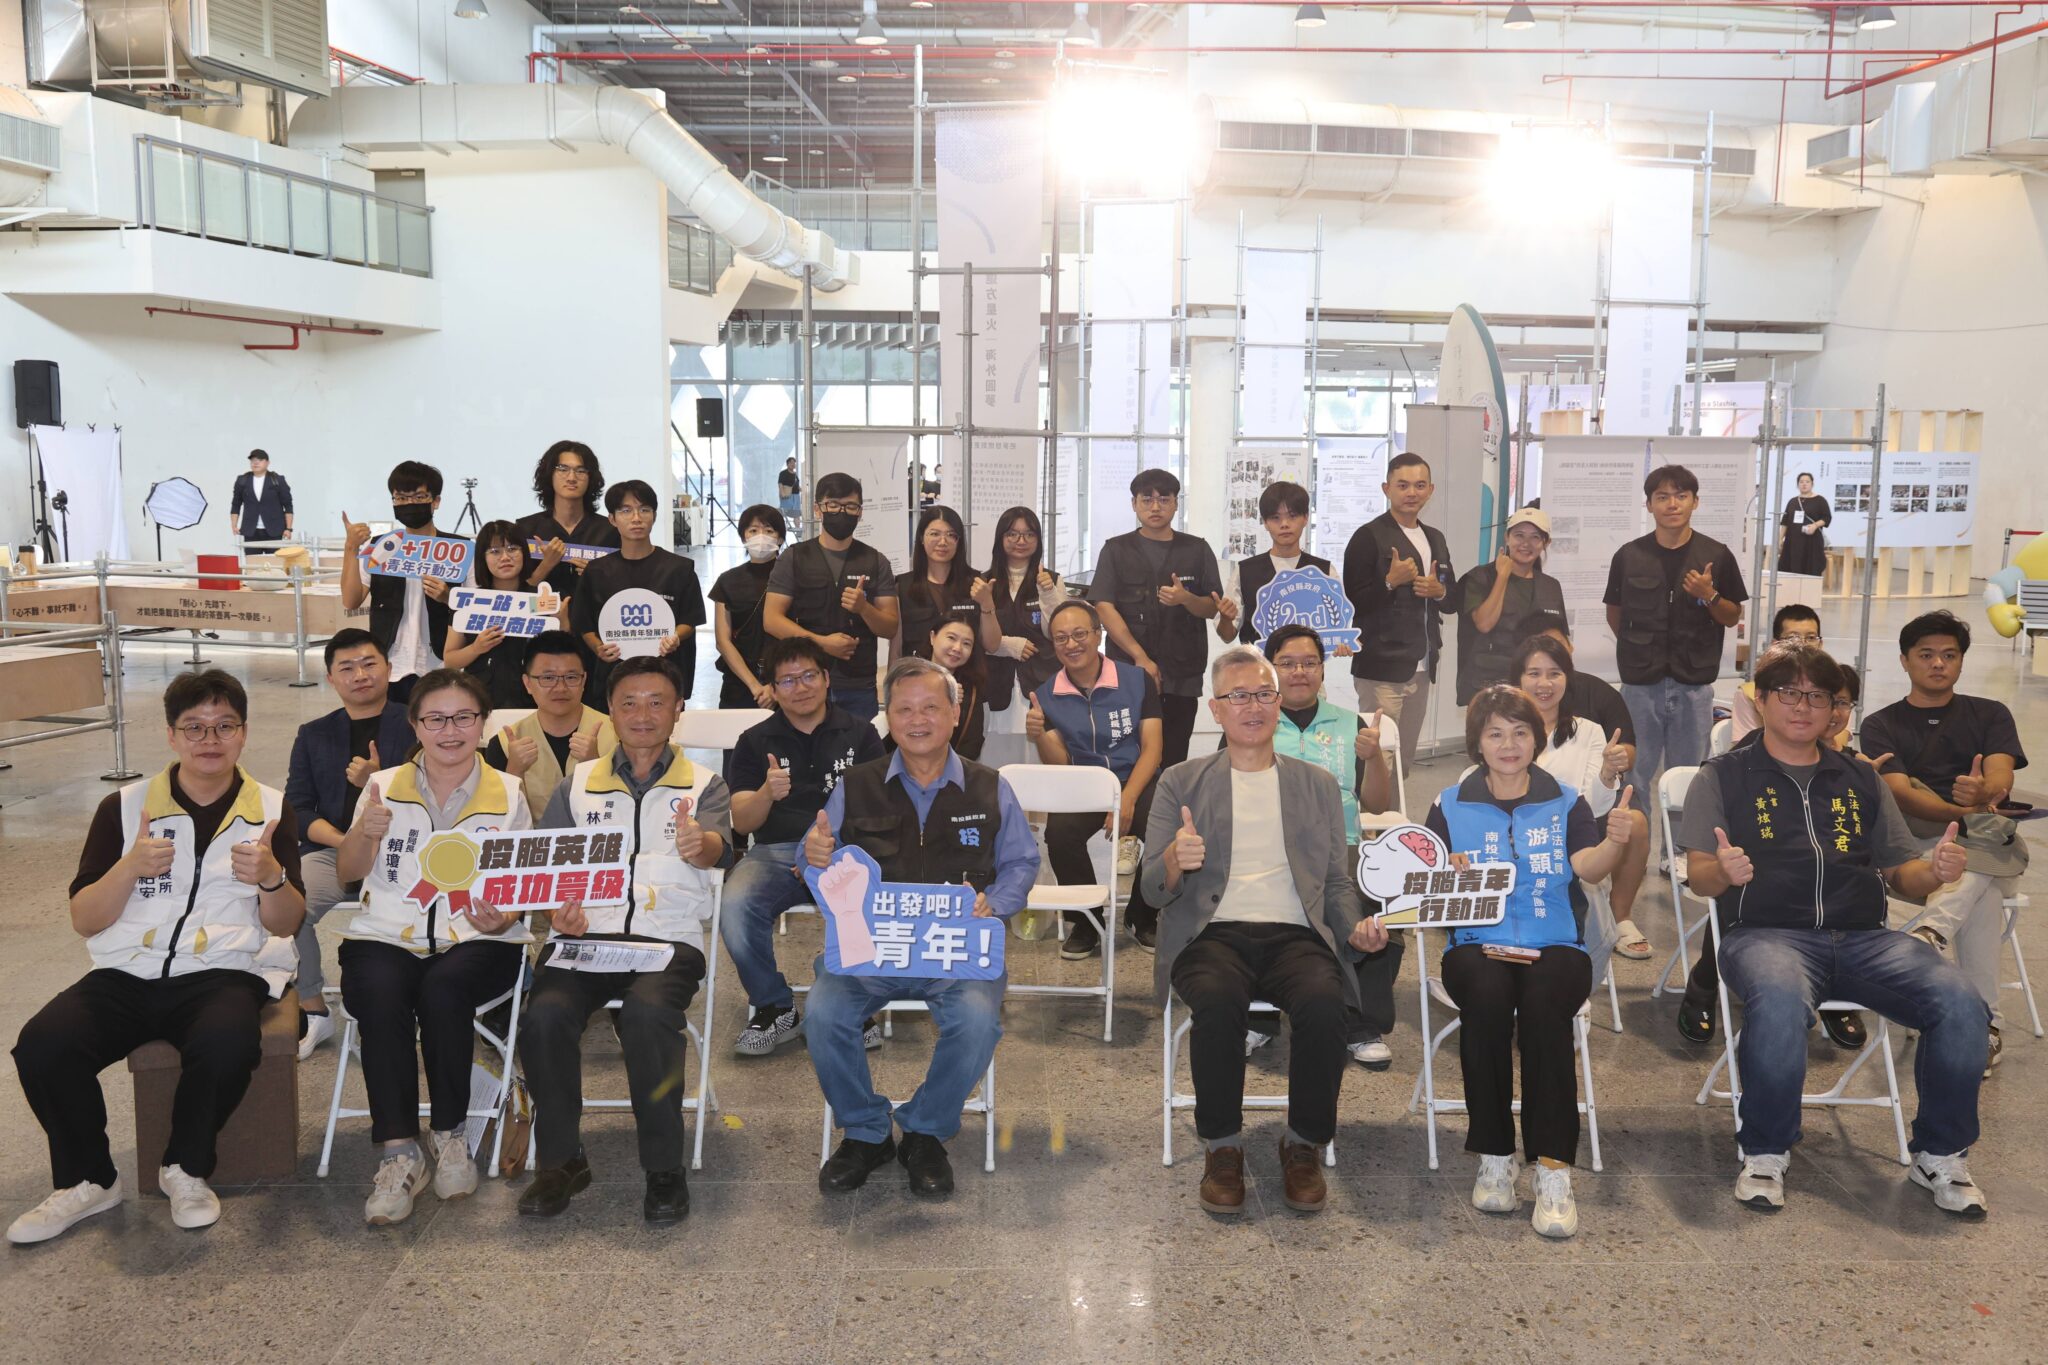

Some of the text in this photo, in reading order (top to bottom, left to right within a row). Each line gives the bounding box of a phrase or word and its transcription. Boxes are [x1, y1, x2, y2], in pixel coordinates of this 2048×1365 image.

[402, 540, 467, 563] +100
[386, 558, 462, 579] 青年行動力
[1280, 602, 1327, 628] 2nd
[605, 629, 669, 637] 南投縣青年發展所
[603, 801, 614, 820] 局長
[1848, 787, 1862, 836] 立法委員
[1831, 797, 1851, 853] 馬文君
[479, 832, 623, 870] 投腦英雄
[1551, 823, 1564, 875] 立法委員
[482, 869, 625, 905] 成功晉級
[1402, 867, 1511, 896] 投腦青年
[1417, 896, 1502, 923] 行動派
